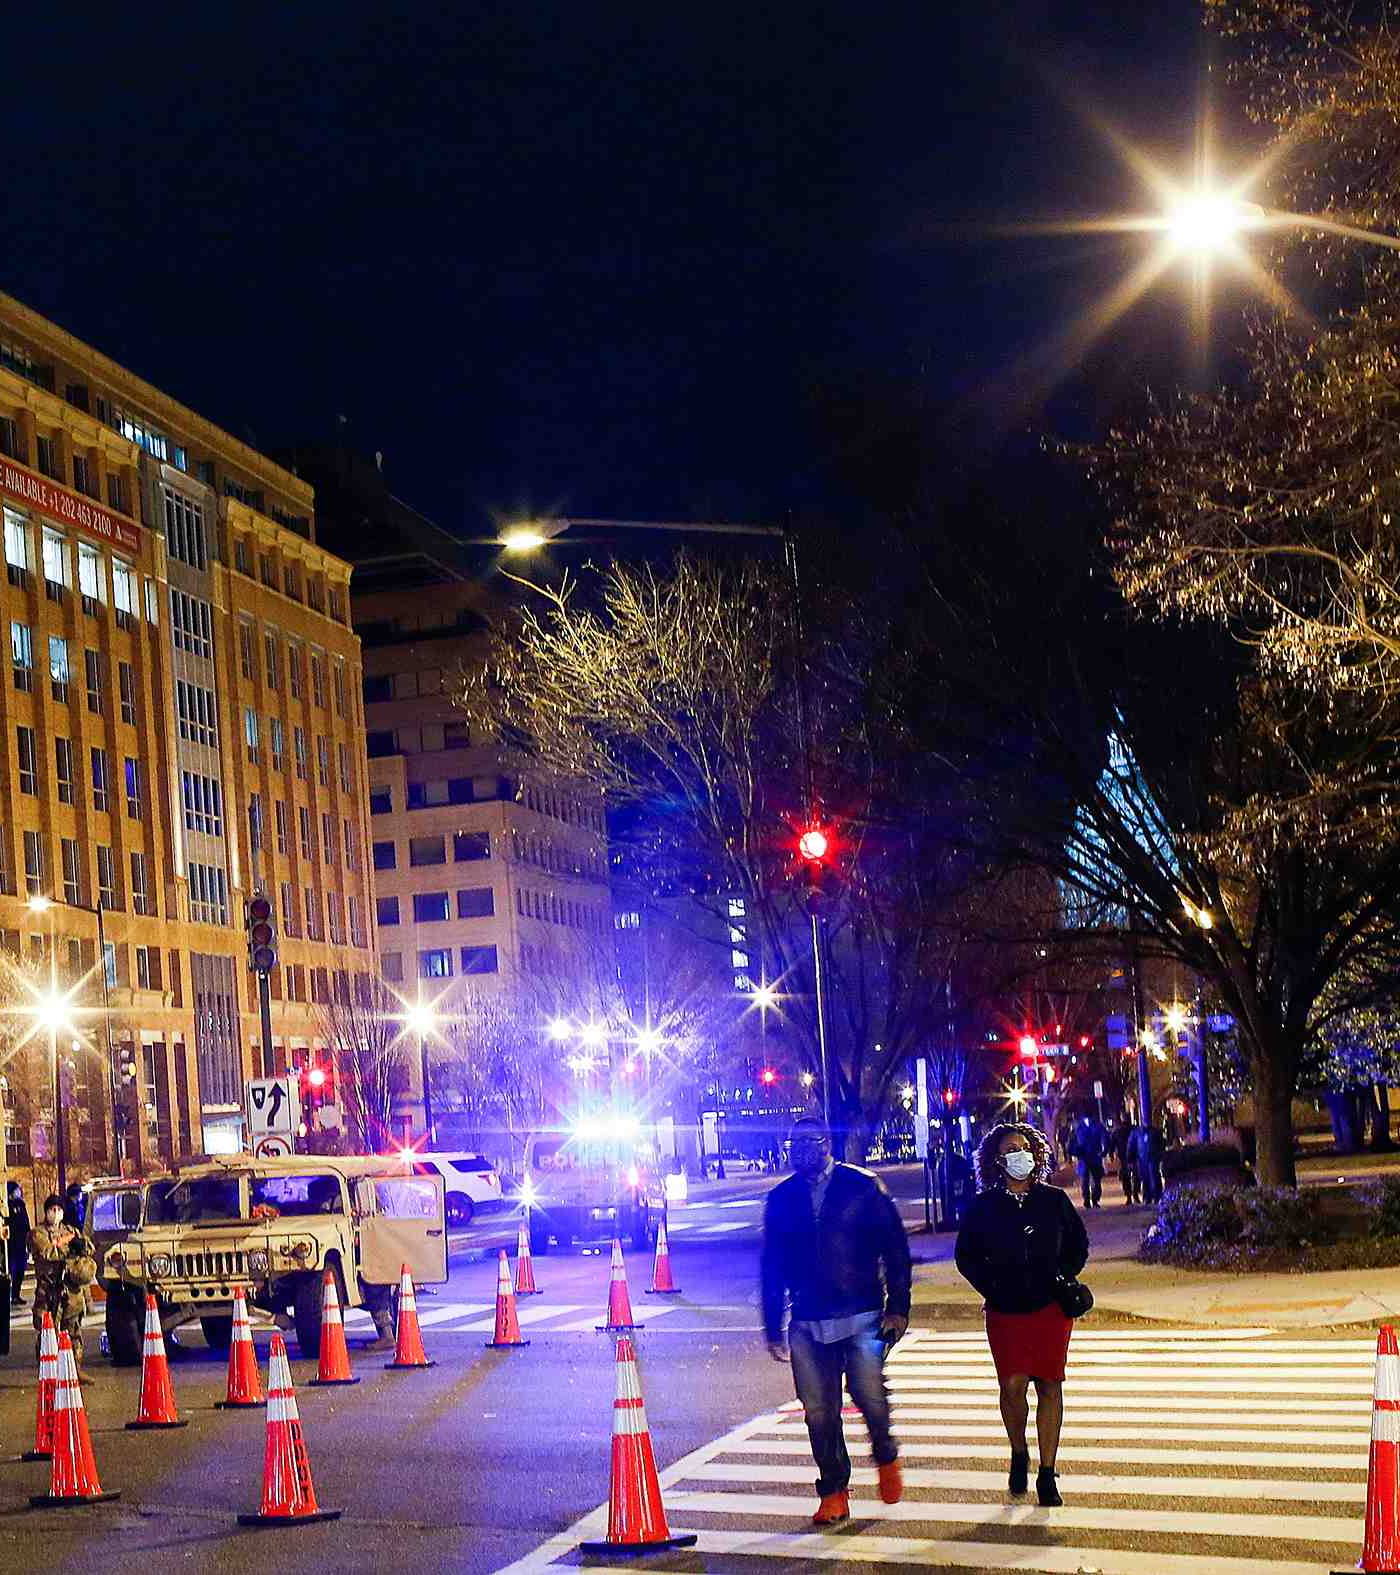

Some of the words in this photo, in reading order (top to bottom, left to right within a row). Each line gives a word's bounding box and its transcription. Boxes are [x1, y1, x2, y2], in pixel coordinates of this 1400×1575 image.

[5, 467, 47, 507] AVAILABLE
[49, 491, 59, 512] +1
[61, 493, 75, 520] 202
[77, 503, 91, 529] 463
[93, 510, 112, 536] 2100
